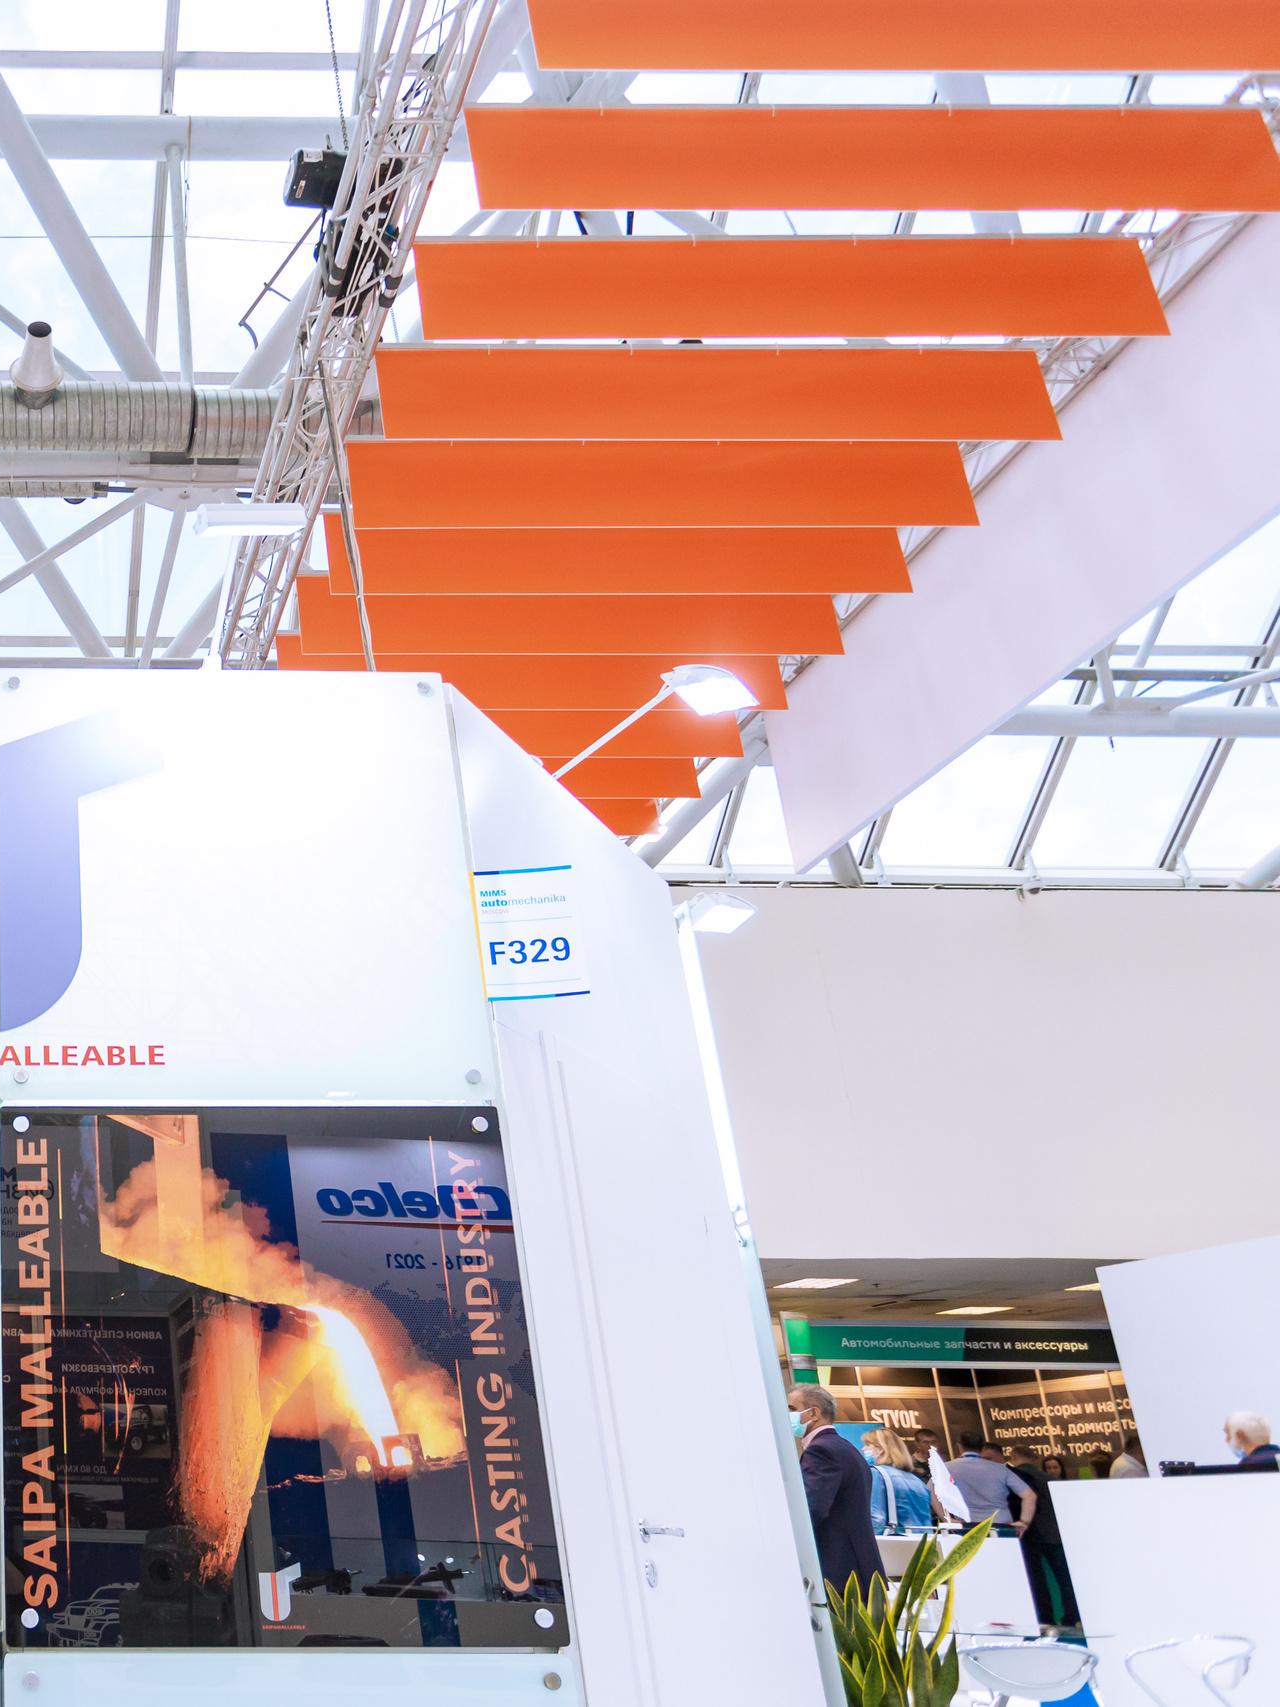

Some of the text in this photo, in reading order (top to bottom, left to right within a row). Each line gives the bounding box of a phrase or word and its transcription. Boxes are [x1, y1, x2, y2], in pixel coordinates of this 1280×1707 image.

[480, 889, 507, 897] MIMS
[481, 894, 566, 907] automechanika
[489, 936, 571, 966] F329
[841, 1337, 1089, 1353] Автомобильные запчасти и аксессуары
[16, 1138, 58, 1609] SAIPA MALLEABLE
[448, 1150, 531, 1593] CASTING INDUSTRY
[990, 1401, 1082, 1422] Компрессоры
[1084, 1401, 1096, 1414] и
